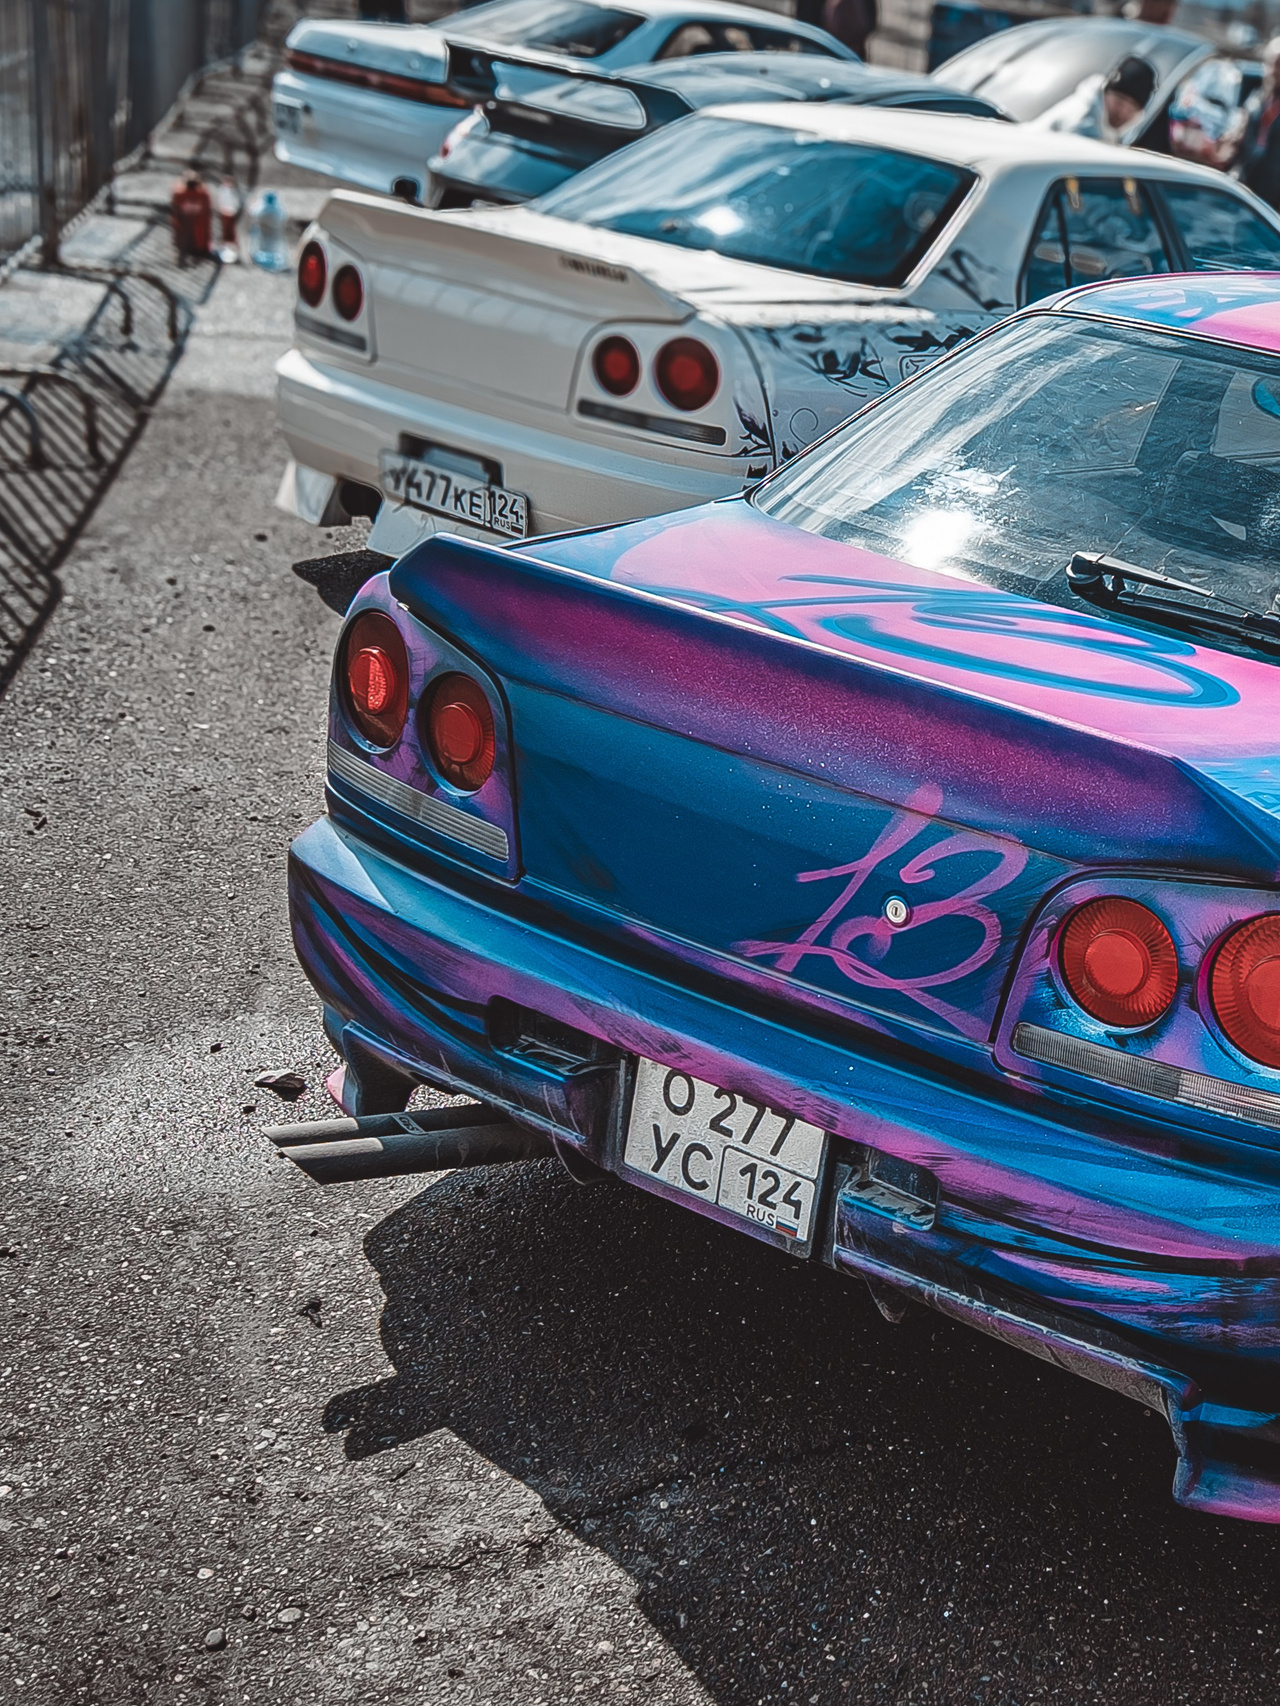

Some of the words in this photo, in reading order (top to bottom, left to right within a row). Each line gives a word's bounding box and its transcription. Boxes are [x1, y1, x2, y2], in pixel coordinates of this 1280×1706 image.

[488, 489, 520, 523] 124
[493, 515, 511, 530] RUS
[708, 1087, 796, 1157] 277
[650, 1123, 714, 1191] УС
[738, 1162, 802, 1220] 124
[746, 1204, 776, 1227] RUS
